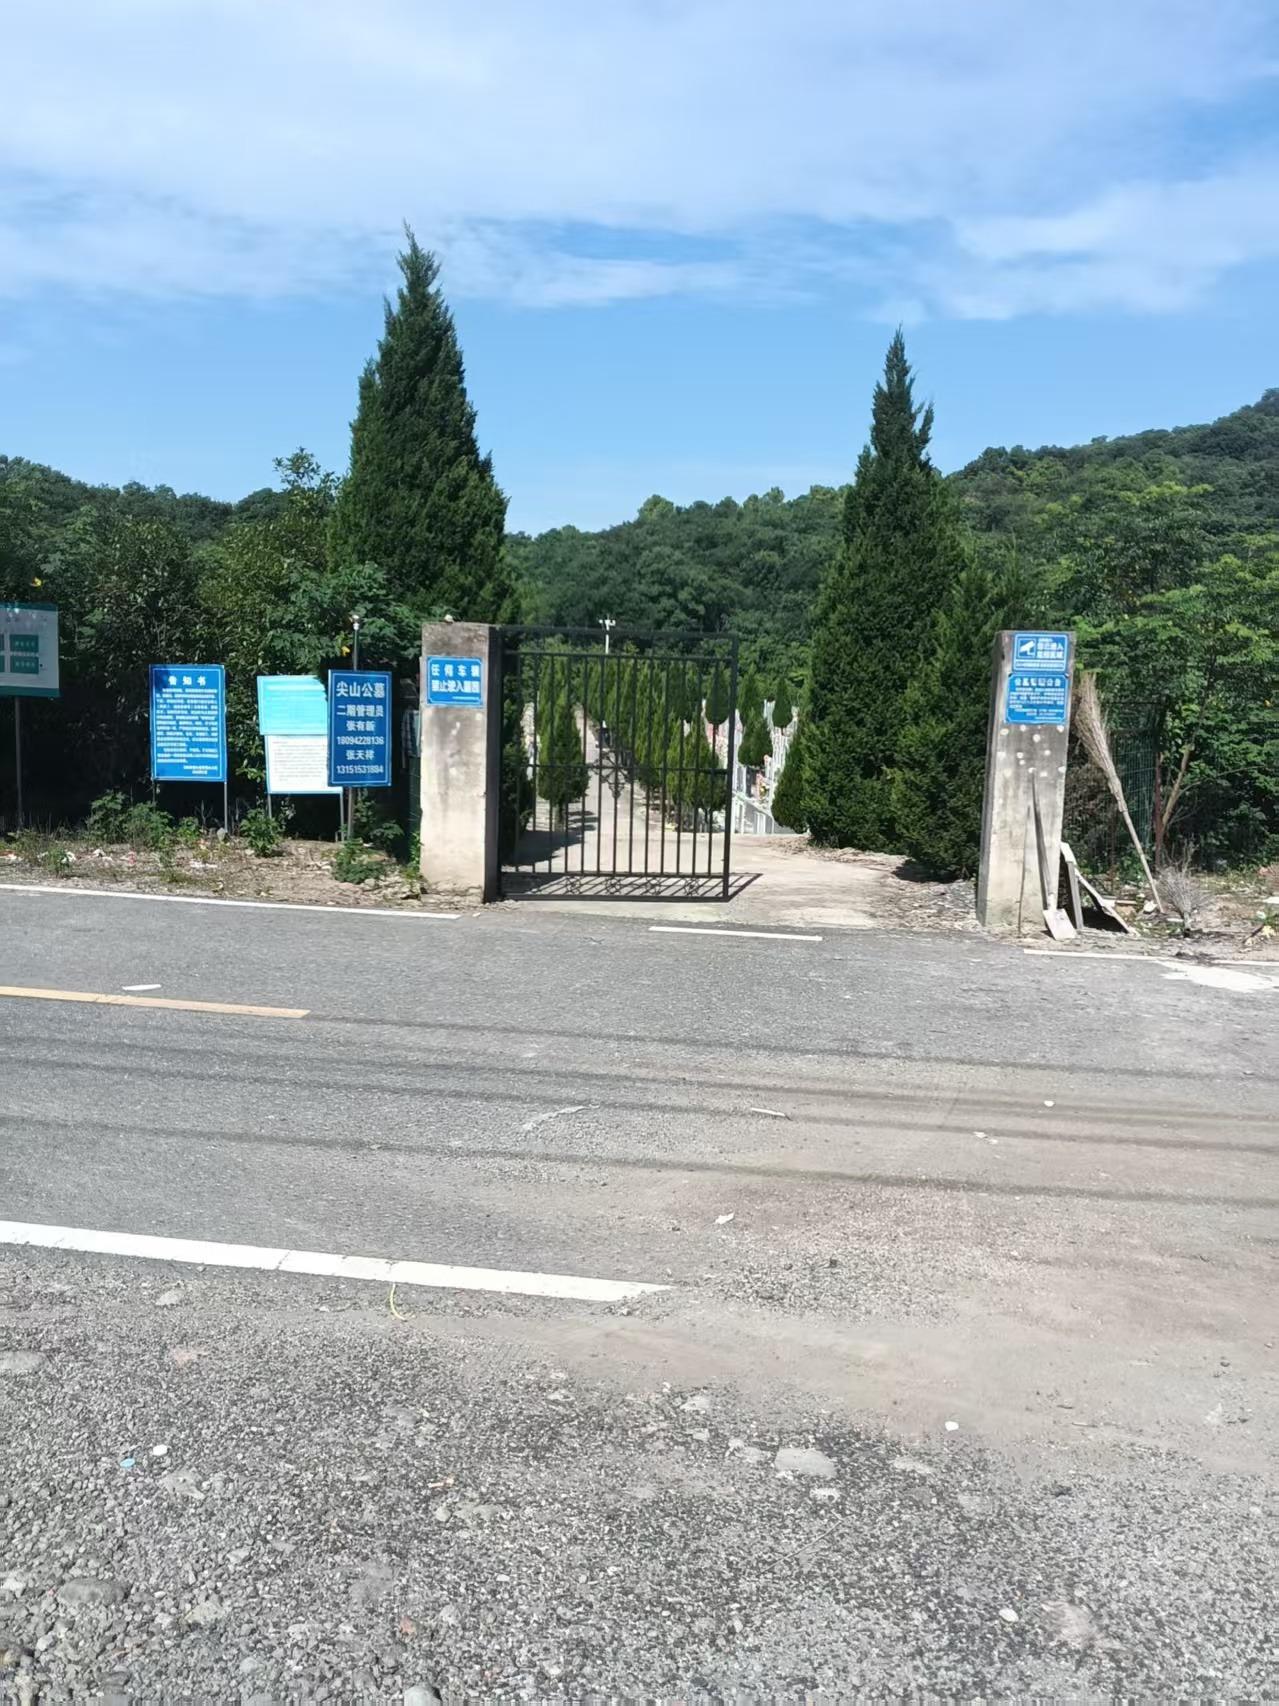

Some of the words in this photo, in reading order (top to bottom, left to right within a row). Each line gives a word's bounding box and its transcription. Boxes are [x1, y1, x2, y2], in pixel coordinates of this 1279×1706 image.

[168, 675, 207, 686] 告知书
[336, 681, 385, 698] 尖山公墓
[336, 705, 384, 718] 二期管理员
